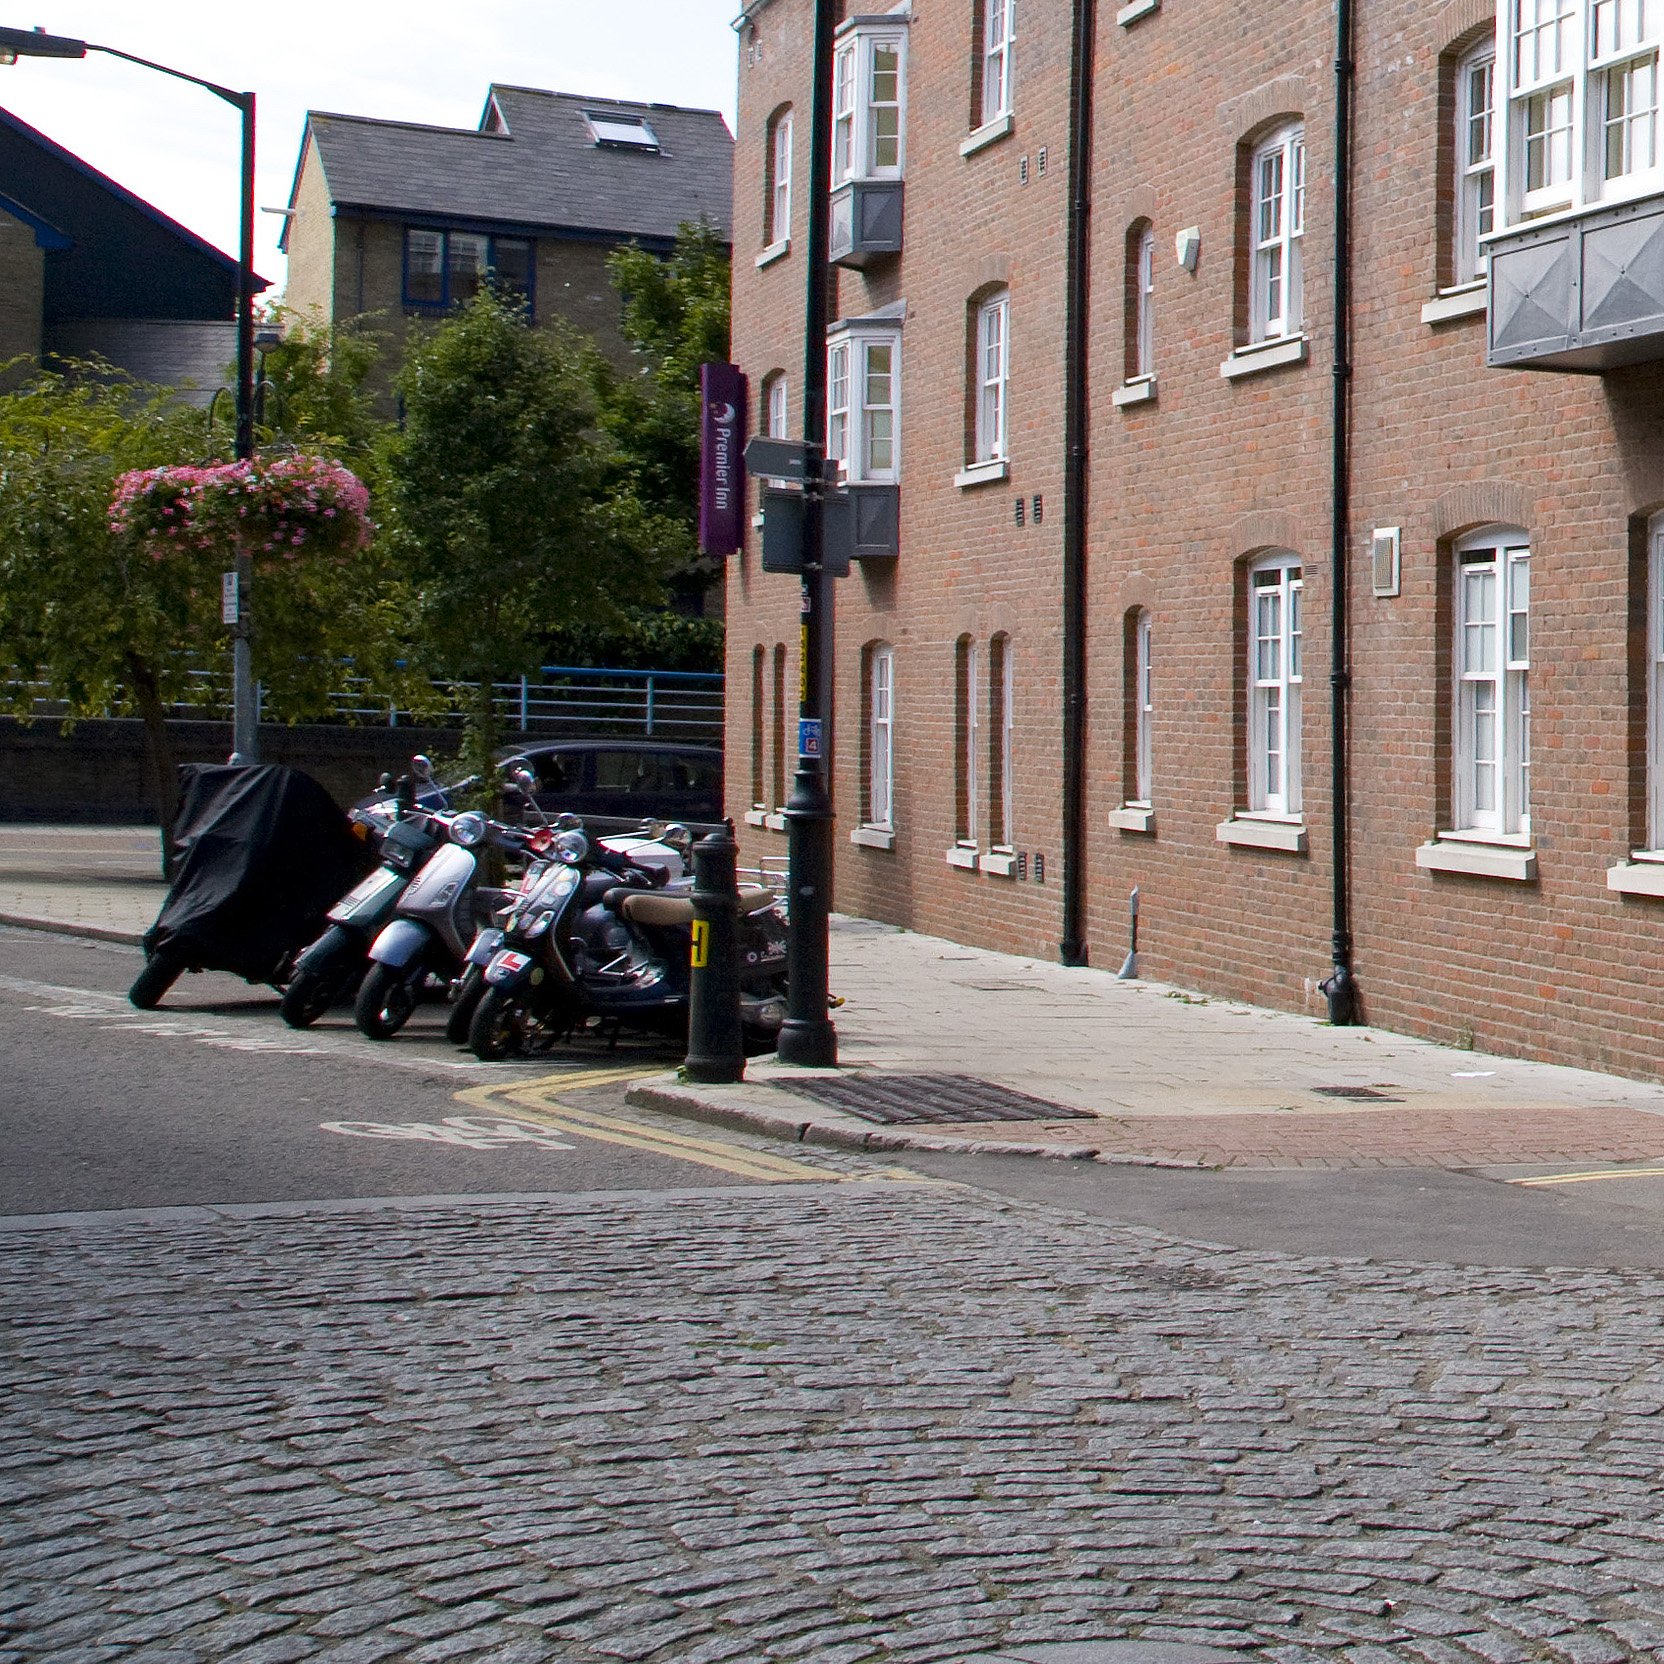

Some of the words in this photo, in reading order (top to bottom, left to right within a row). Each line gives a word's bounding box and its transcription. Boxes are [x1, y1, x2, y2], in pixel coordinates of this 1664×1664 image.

[715, 427, 731, 481] Premier
[715, 486, 731, 510] Inn
[807, 738, 817, 752] 4
[501, 954, 521, 970] L
